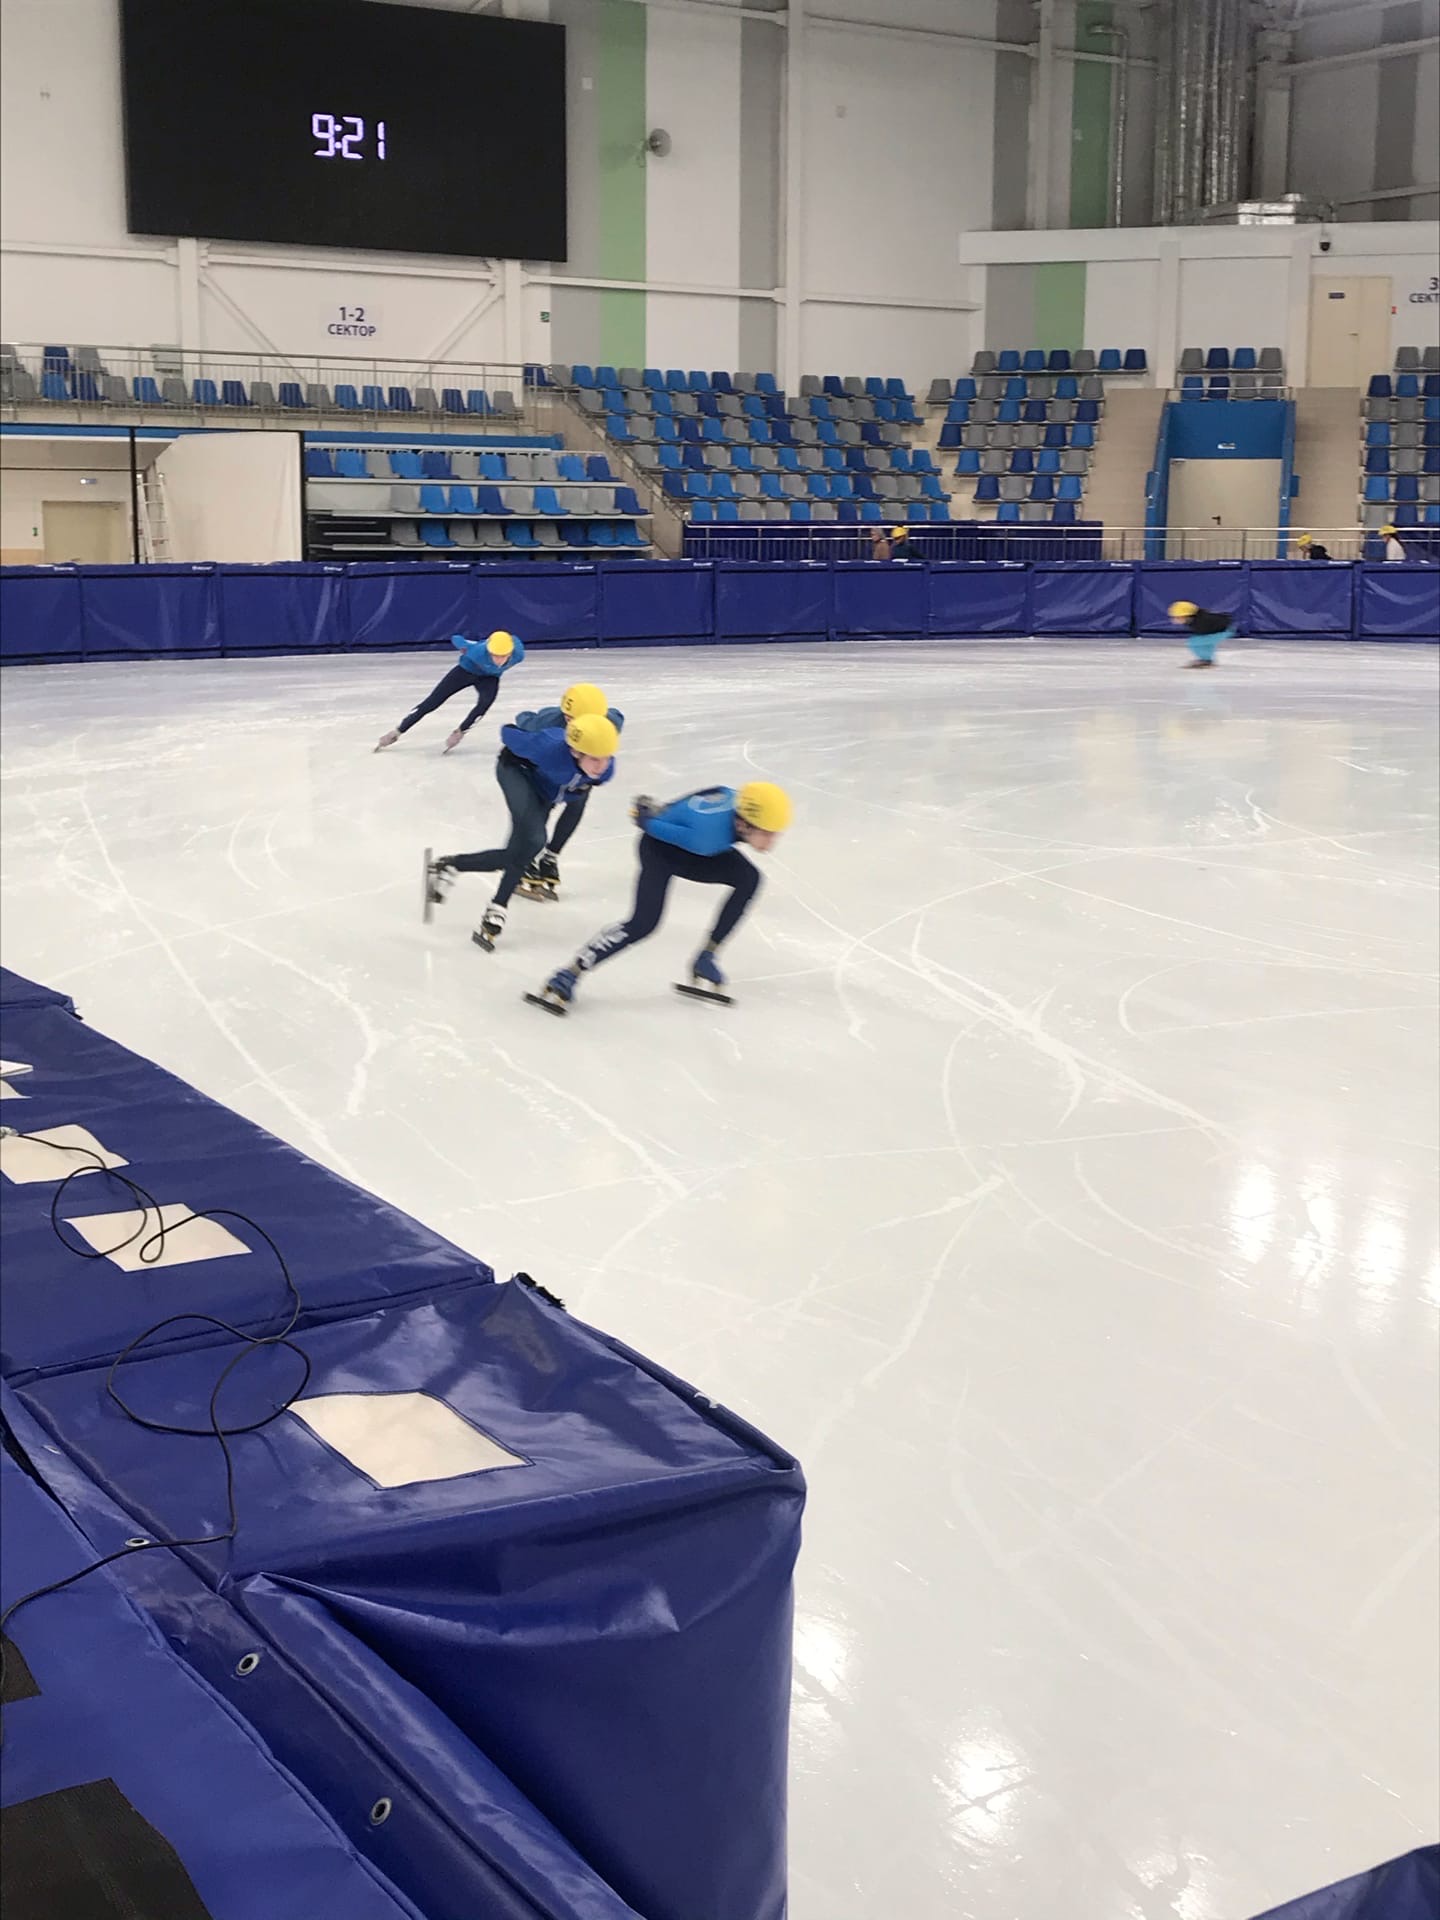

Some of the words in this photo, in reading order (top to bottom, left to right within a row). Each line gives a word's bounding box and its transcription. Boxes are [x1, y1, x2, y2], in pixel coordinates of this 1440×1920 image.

[312, 113, 385, 160] 9:21
[339, 306, 365, 322] 1-2
[327, 323, 377, 337] СЕКТОР
